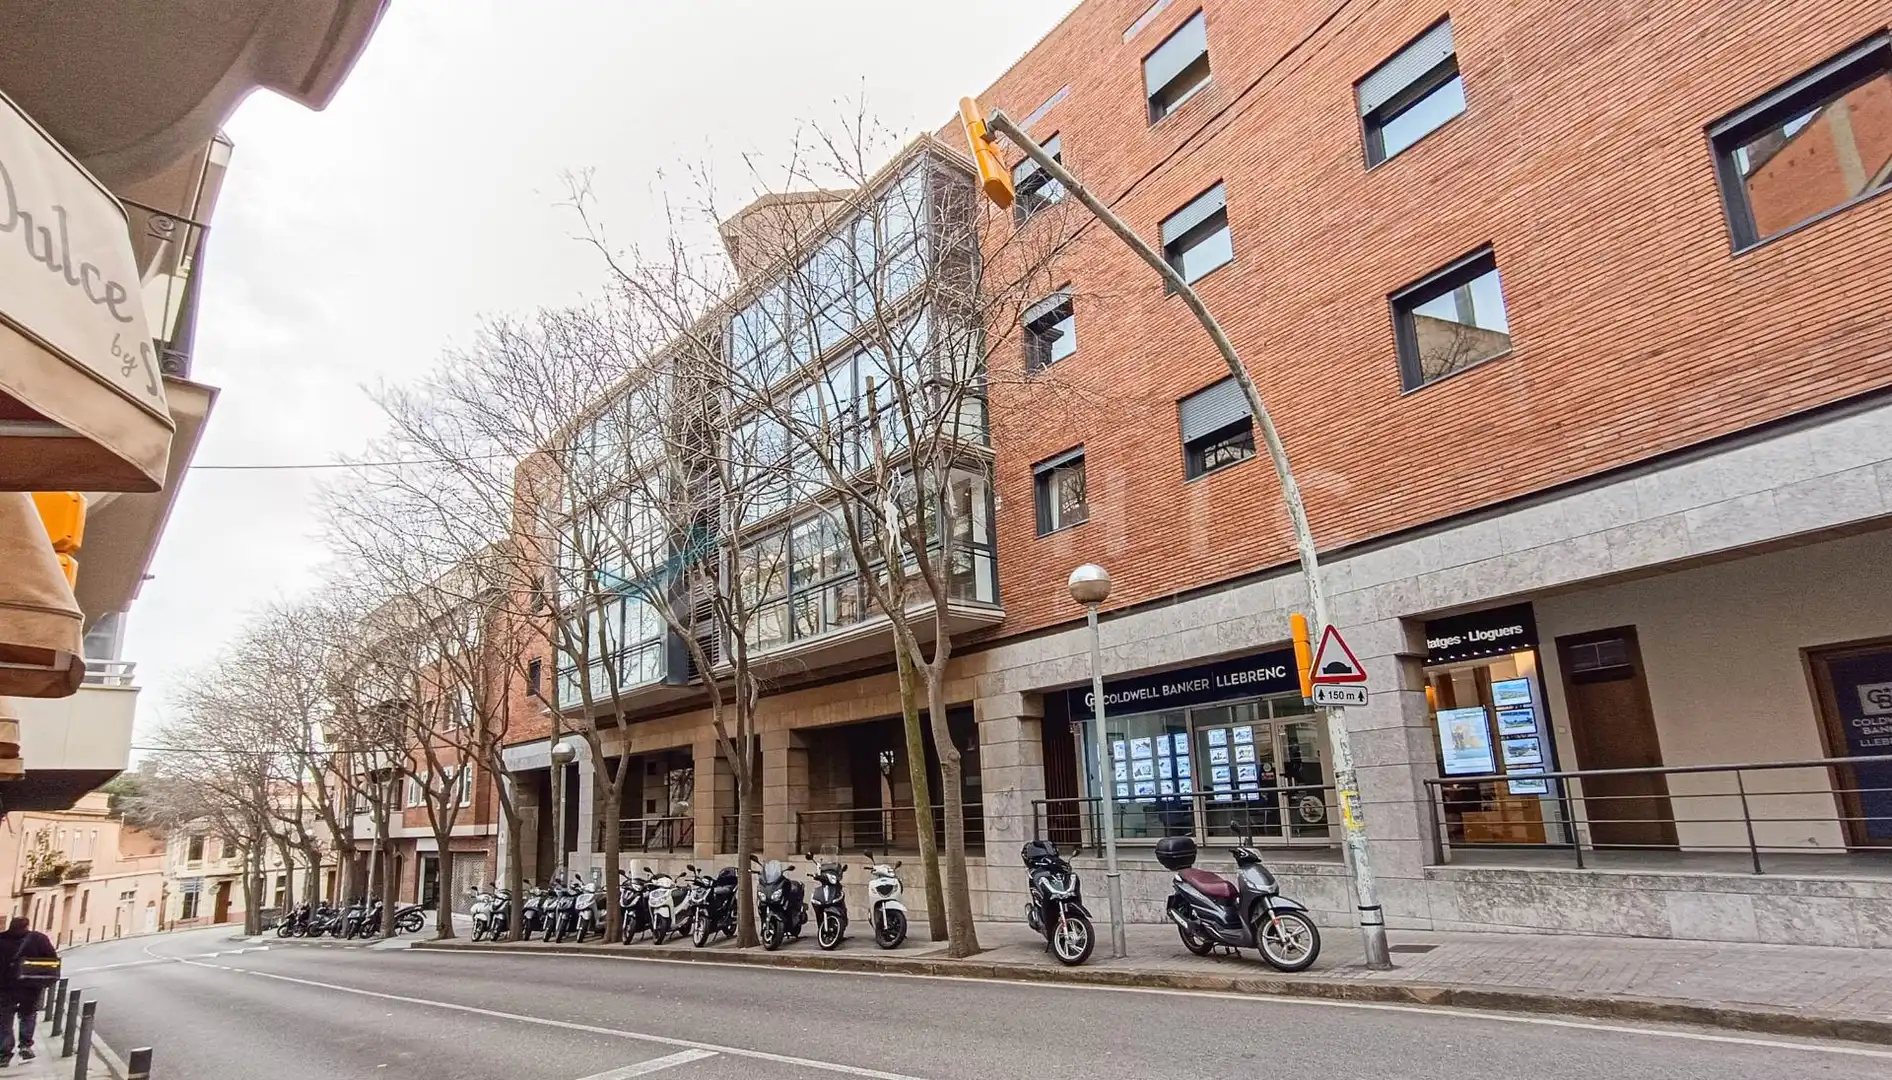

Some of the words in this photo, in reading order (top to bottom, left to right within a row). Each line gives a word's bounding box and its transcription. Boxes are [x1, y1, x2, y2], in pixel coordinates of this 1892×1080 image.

[111, 333, 138, 378] by
[1426, 635, 1462, 649] tatges
[1468, 625, 1523, 642] Lloguers
[1103, 687, 1160, 705] COLDWELL
[1162, 679, 1210, 696] BANKER
[1216, 666, 1287, 687] LLEBRENC
[1328, 690, 1344, 700] 150
[1859, 737, 1892, 747] LLEB
